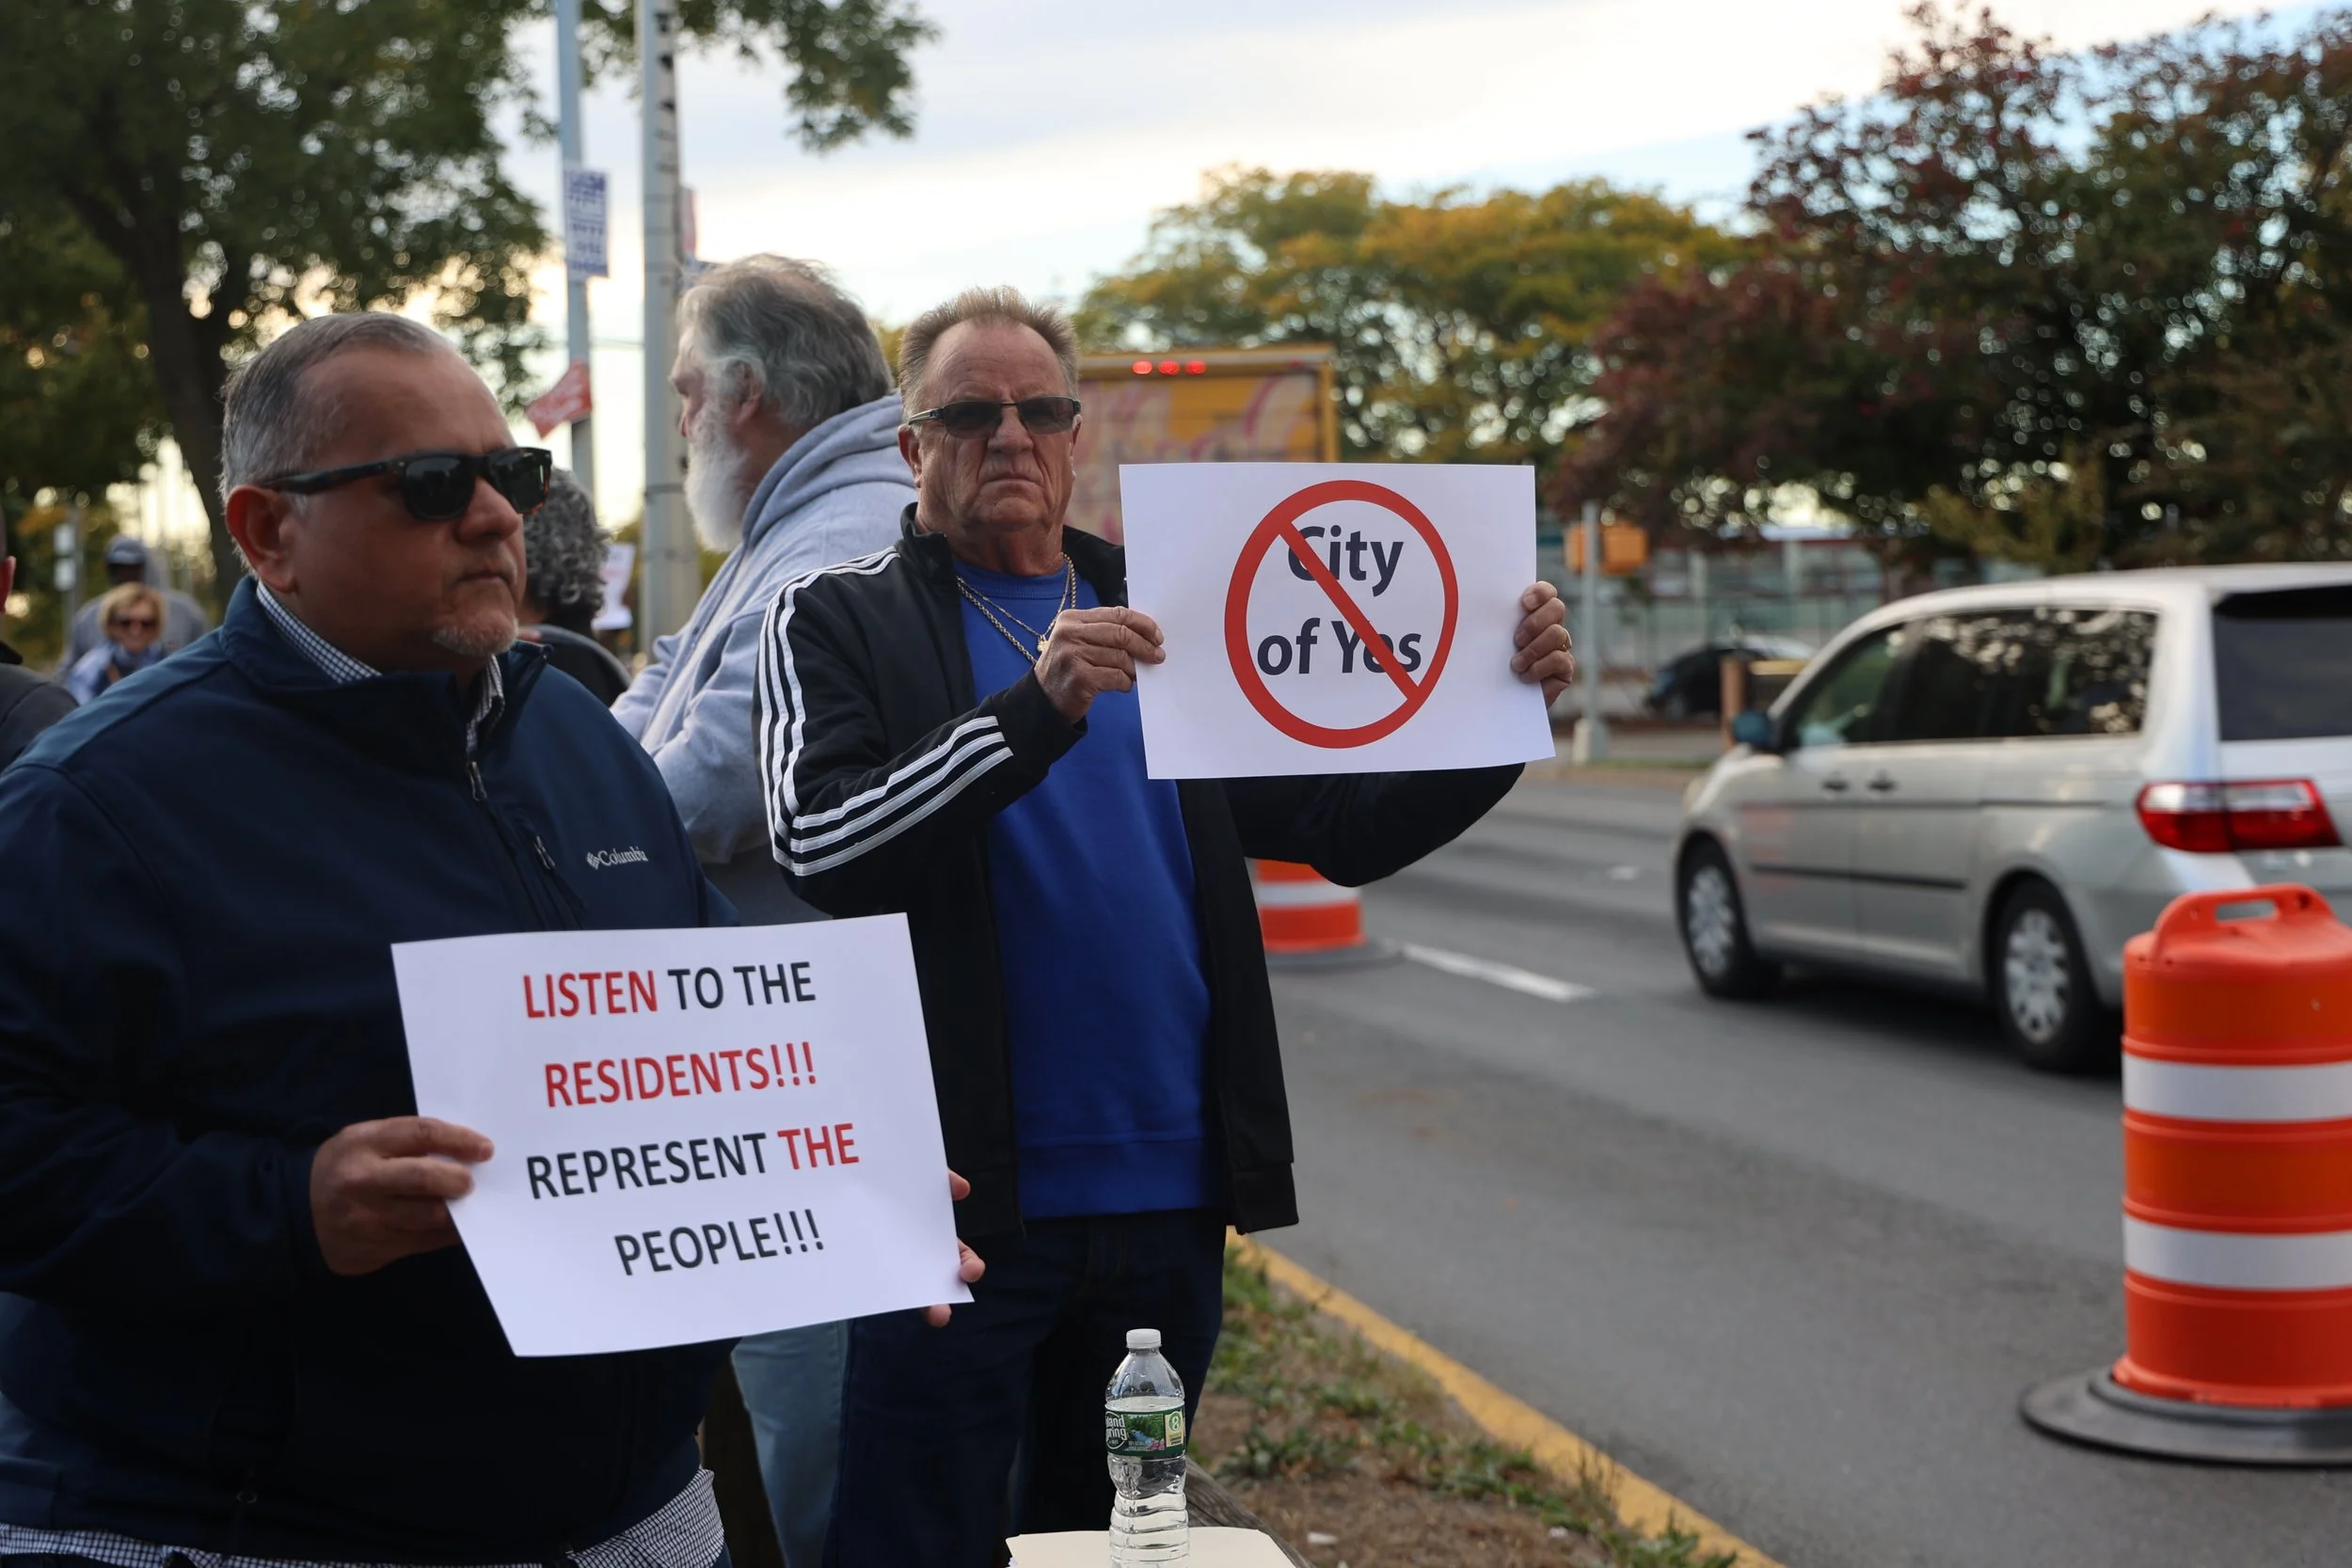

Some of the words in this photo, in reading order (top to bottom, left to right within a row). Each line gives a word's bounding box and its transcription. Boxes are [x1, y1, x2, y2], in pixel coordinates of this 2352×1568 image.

[1287, 525, 1405, 597] City
[1257, 617, 1321, 676] of
[1330, 620, 1422, 673] Yes
[523, 970, 658, 1019] LISTEN
[667, 967, 724, 1010] TO
[733, 961, 817, 1006] THE
[545, 1041, 817, 1107] RESIDENTS!!!
[527, 1132, 767, 1200] REPRESENT
[777, 1123, 860, 1170] THE
[614, 1209, 824, 1276] PEOPLE!!!
